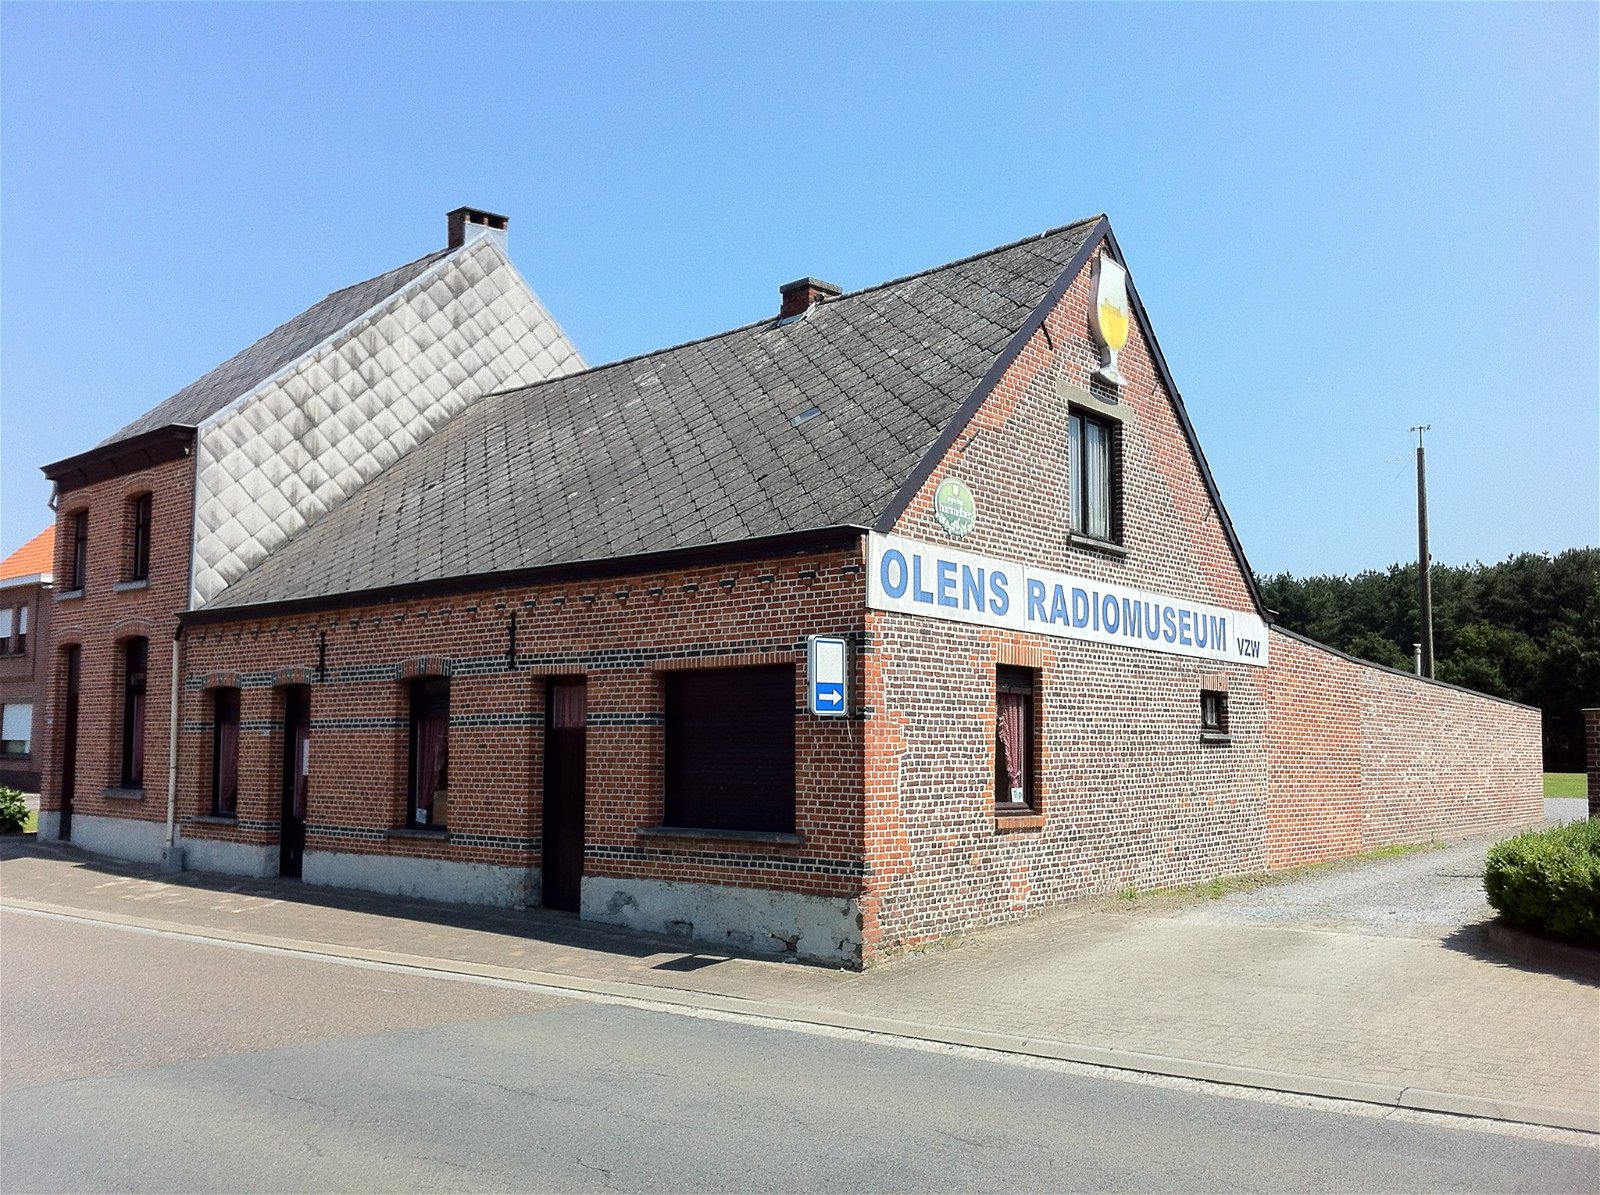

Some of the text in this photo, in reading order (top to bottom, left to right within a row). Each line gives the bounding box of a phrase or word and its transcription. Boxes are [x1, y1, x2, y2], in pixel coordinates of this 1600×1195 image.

[881, 549, 1260, 659] OLENS RADIOMUSEUM VZW
